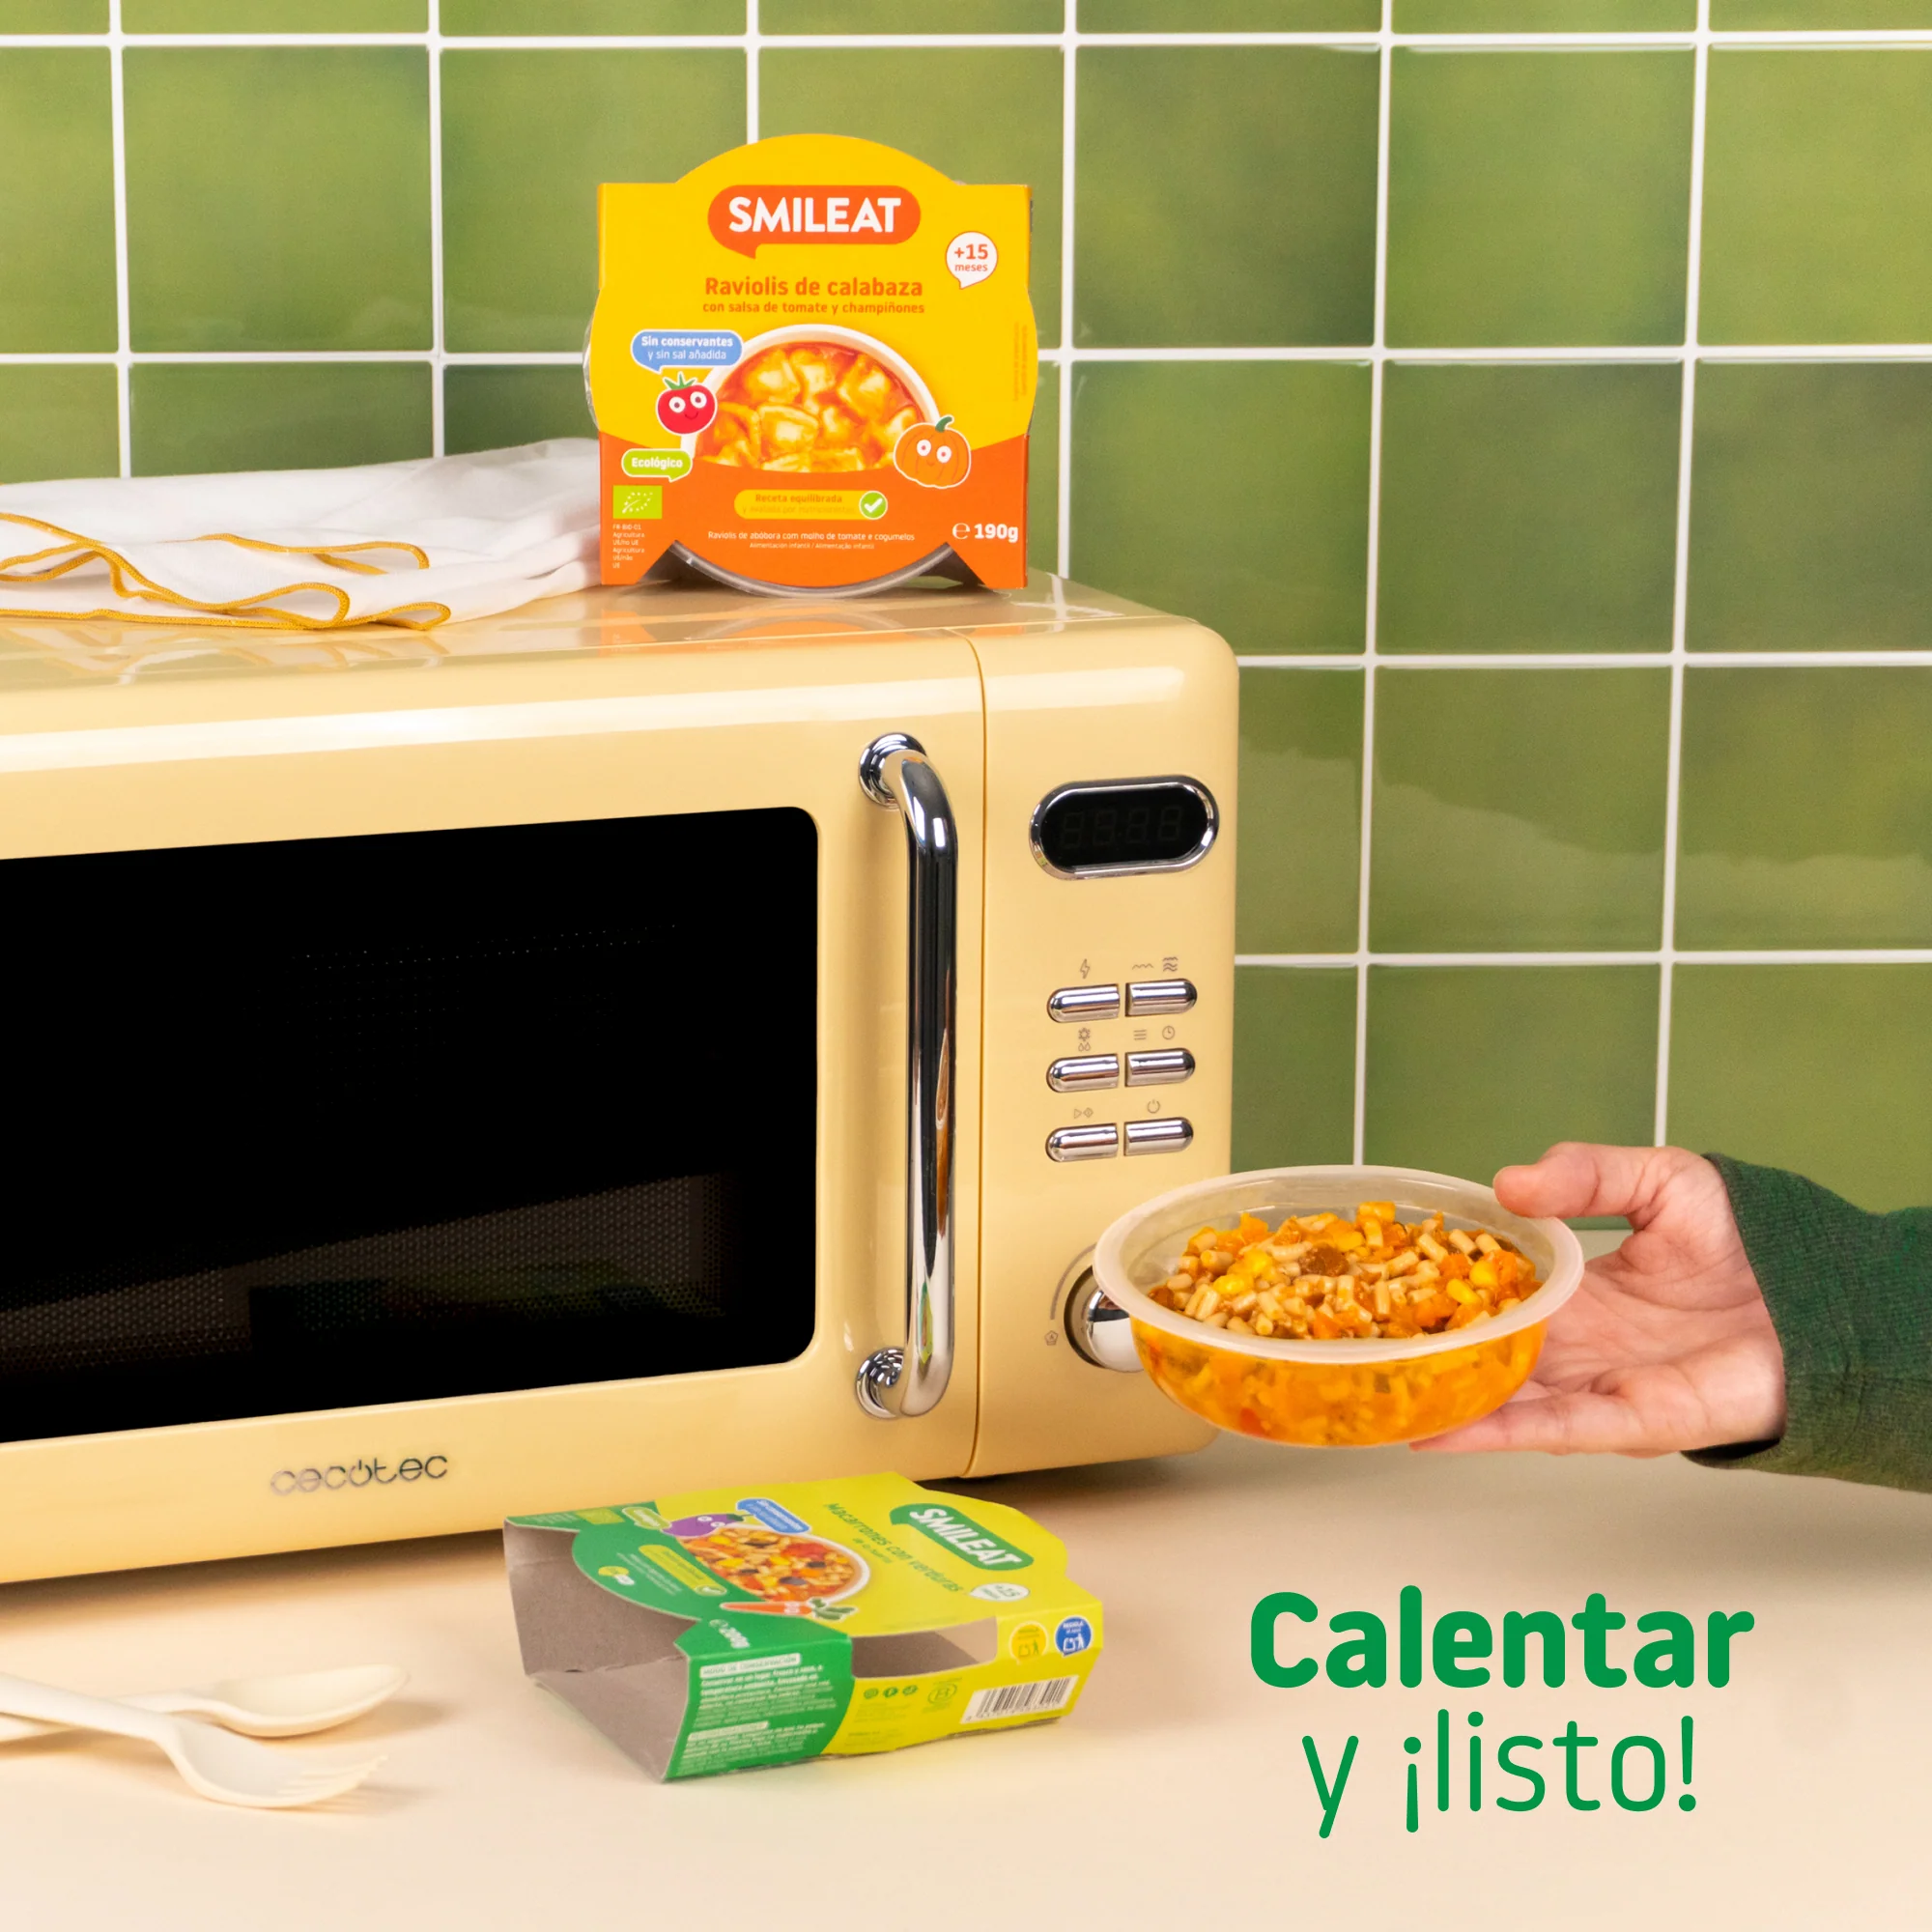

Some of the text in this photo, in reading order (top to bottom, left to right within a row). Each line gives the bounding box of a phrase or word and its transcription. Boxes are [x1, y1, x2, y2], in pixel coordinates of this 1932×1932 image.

[728, 196, 901, 233] SMILEAT
[954, 243, 988, 260] +15
[954, 263, 988, 271] meses
[705, 276, 923, 297] Raviolis de calabaza
[703, 301, 924, 316] con salsa de tomate y champiñones
[641, 335, 733, 347] Sin conservantes
[647, 349, 726, 361] y sin sal añadida
[631, 456, 683, 470] Ecológico
[755, 494, 842, 504] Receta equilibrada
[708, 530, 736, 539] Raviolis
[738, 531, 748, 540] de
[750, 530, 781, 540] abóbora
[801, 531, 824, 540] molho
[826, 531, 836, 540] de
[838, 532, 866, 541] tomate
[874, 532, 915, 542] cogumelos
[974, 523, 1018, 543] 190g
[909, 1508, 1022, 1565] SMILEAT
[823, 1503, 892, 1547] Macarrones
[886, 1545, 912, 1561] con
[909, 1559, 963, 1592] verduras
